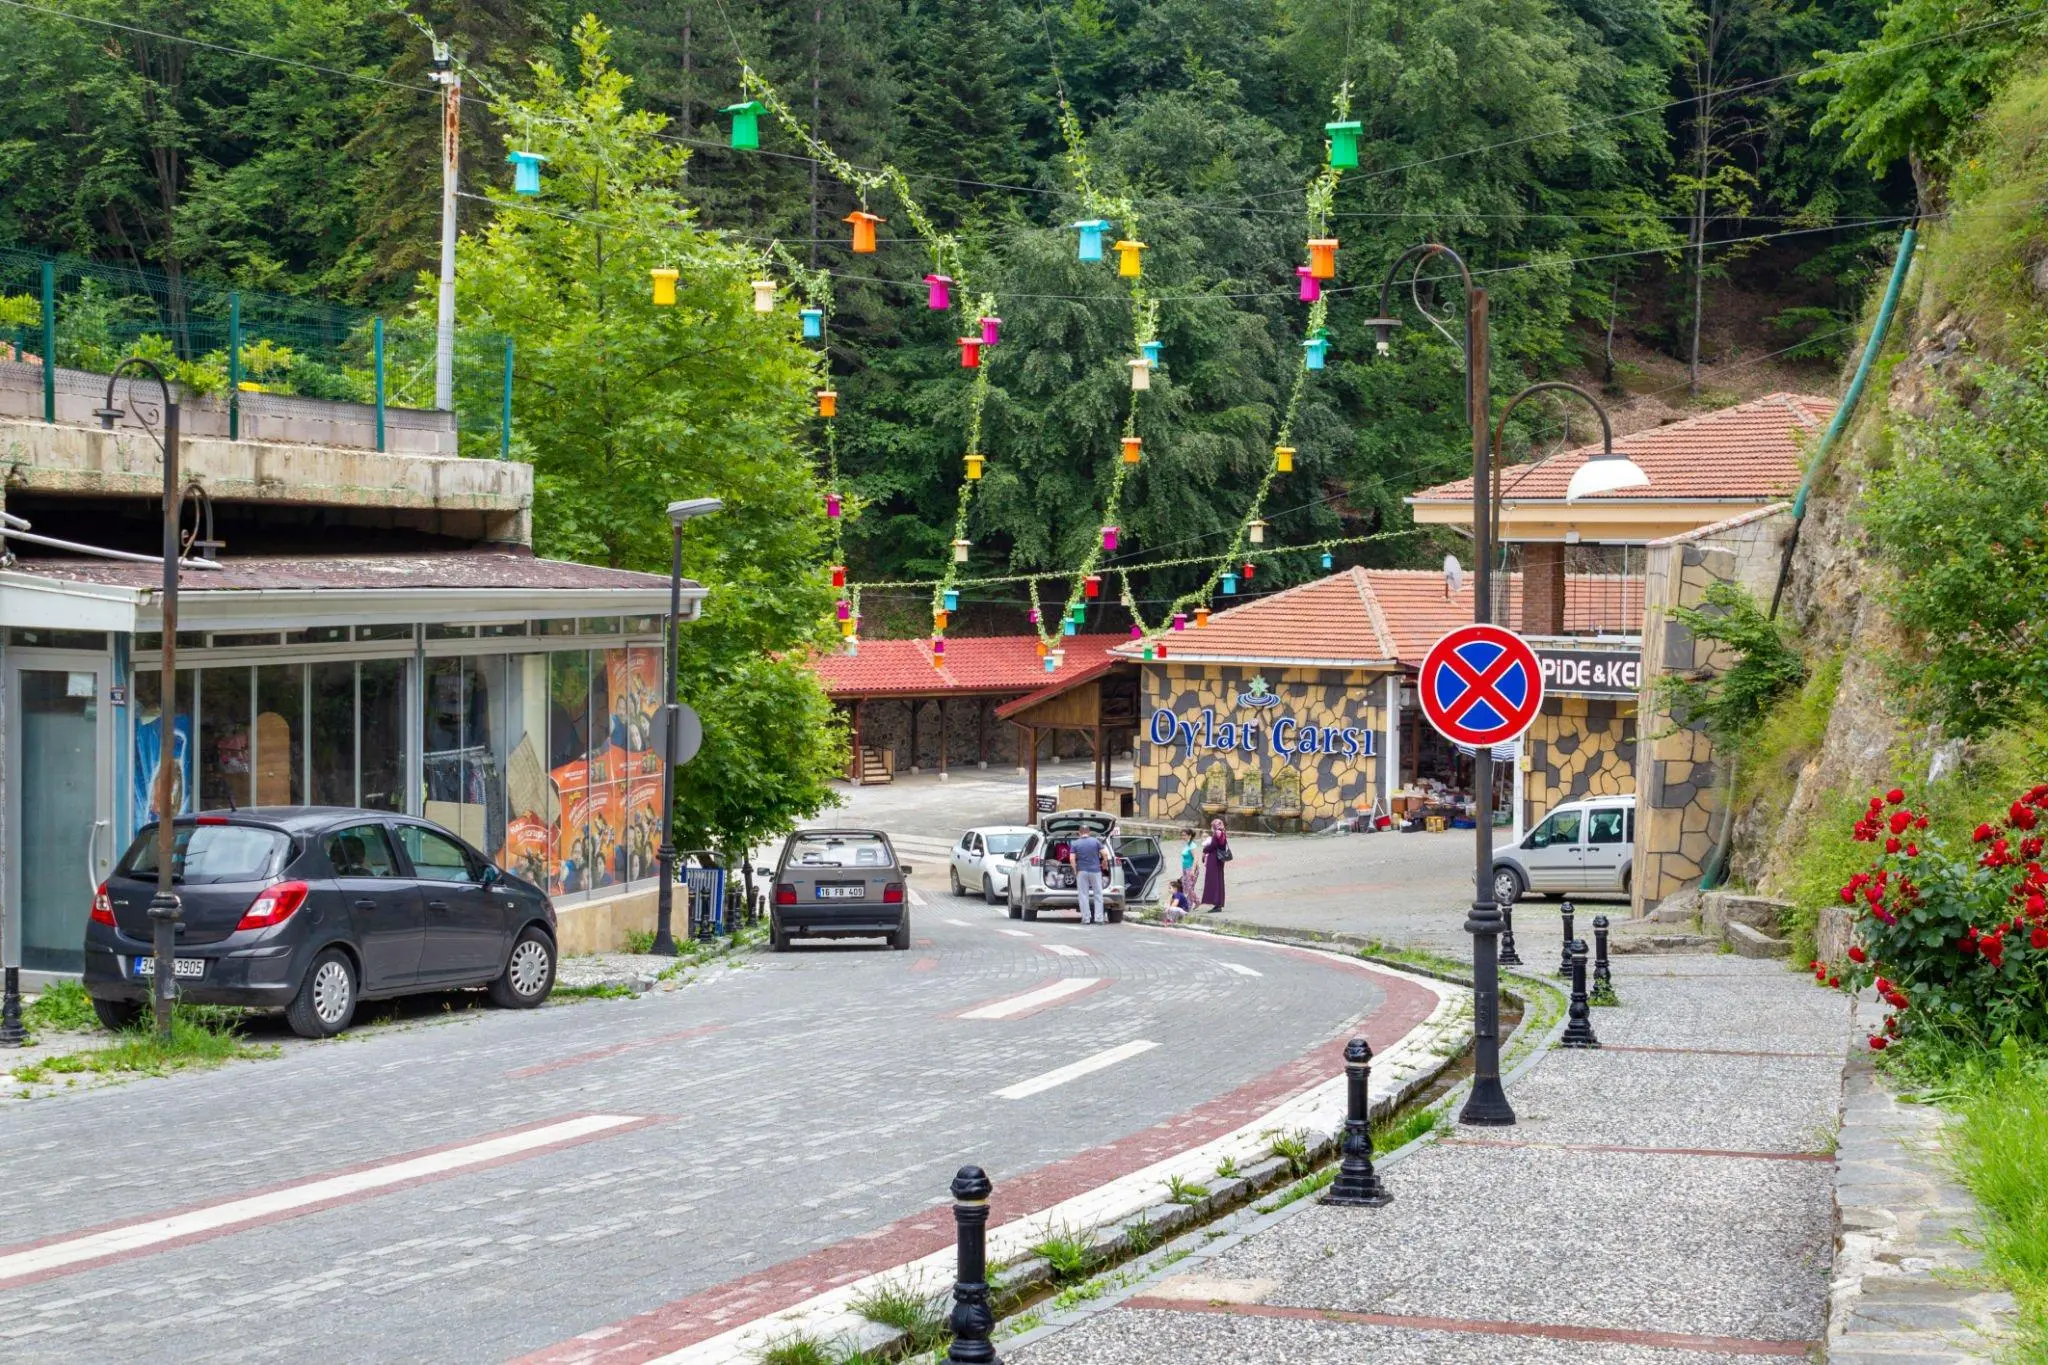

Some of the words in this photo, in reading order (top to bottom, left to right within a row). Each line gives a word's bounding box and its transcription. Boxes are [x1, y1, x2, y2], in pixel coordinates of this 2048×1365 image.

[1150, 708, 1258, 759] Oylat
[1272, 717, 1377, 765] Çarşı
[821, 888, 830, 896] 16
[848, 888, 863, 896] 409
[141, 958, 154, 973] 34
[176, 960, 203, 975] 3905
